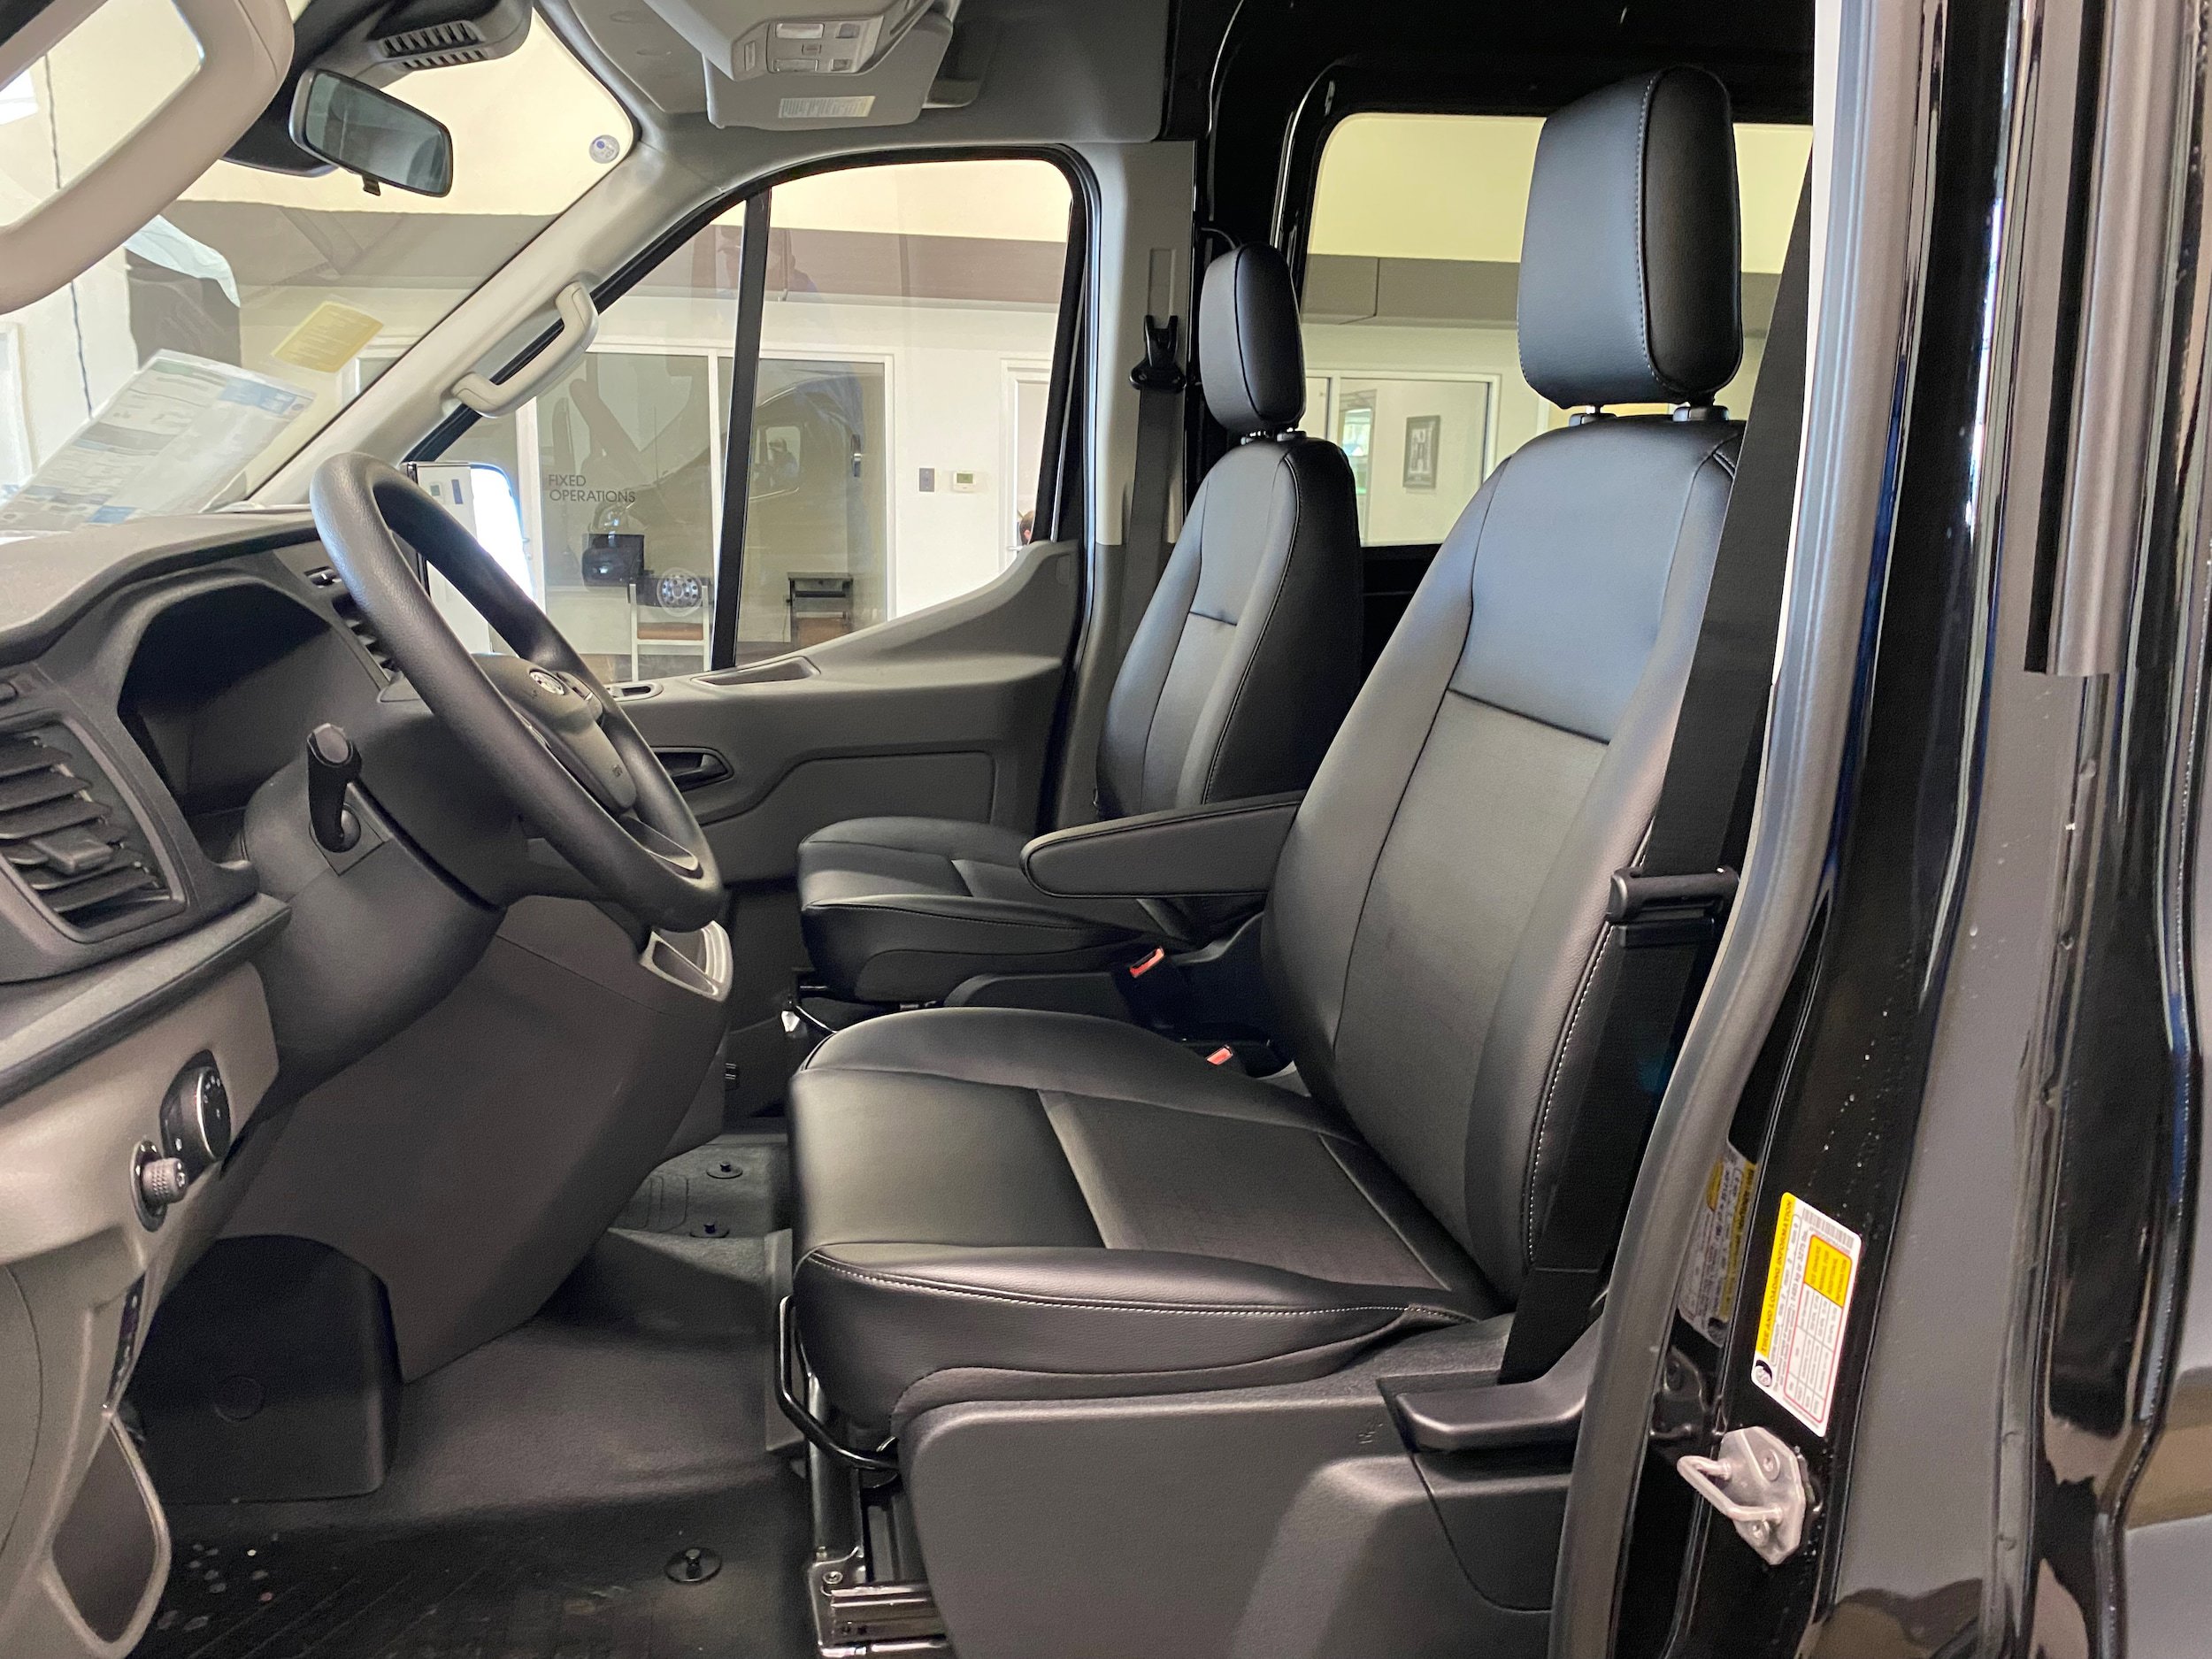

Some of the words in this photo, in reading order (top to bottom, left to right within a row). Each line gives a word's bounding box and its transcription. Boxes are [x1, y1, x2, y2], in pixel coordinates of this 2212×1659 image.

[549, 474, 587, 487] FIXED
[549, 489, 636, 503] OPERATIONS
[1775, 1198, 1793, 1266] INFORMATION
[1768, 1265, 1780, 1309] LOADING
[1764, 1308, 1773, 1331] AND
[1760, 1328, 1770, 1354] TIRE
